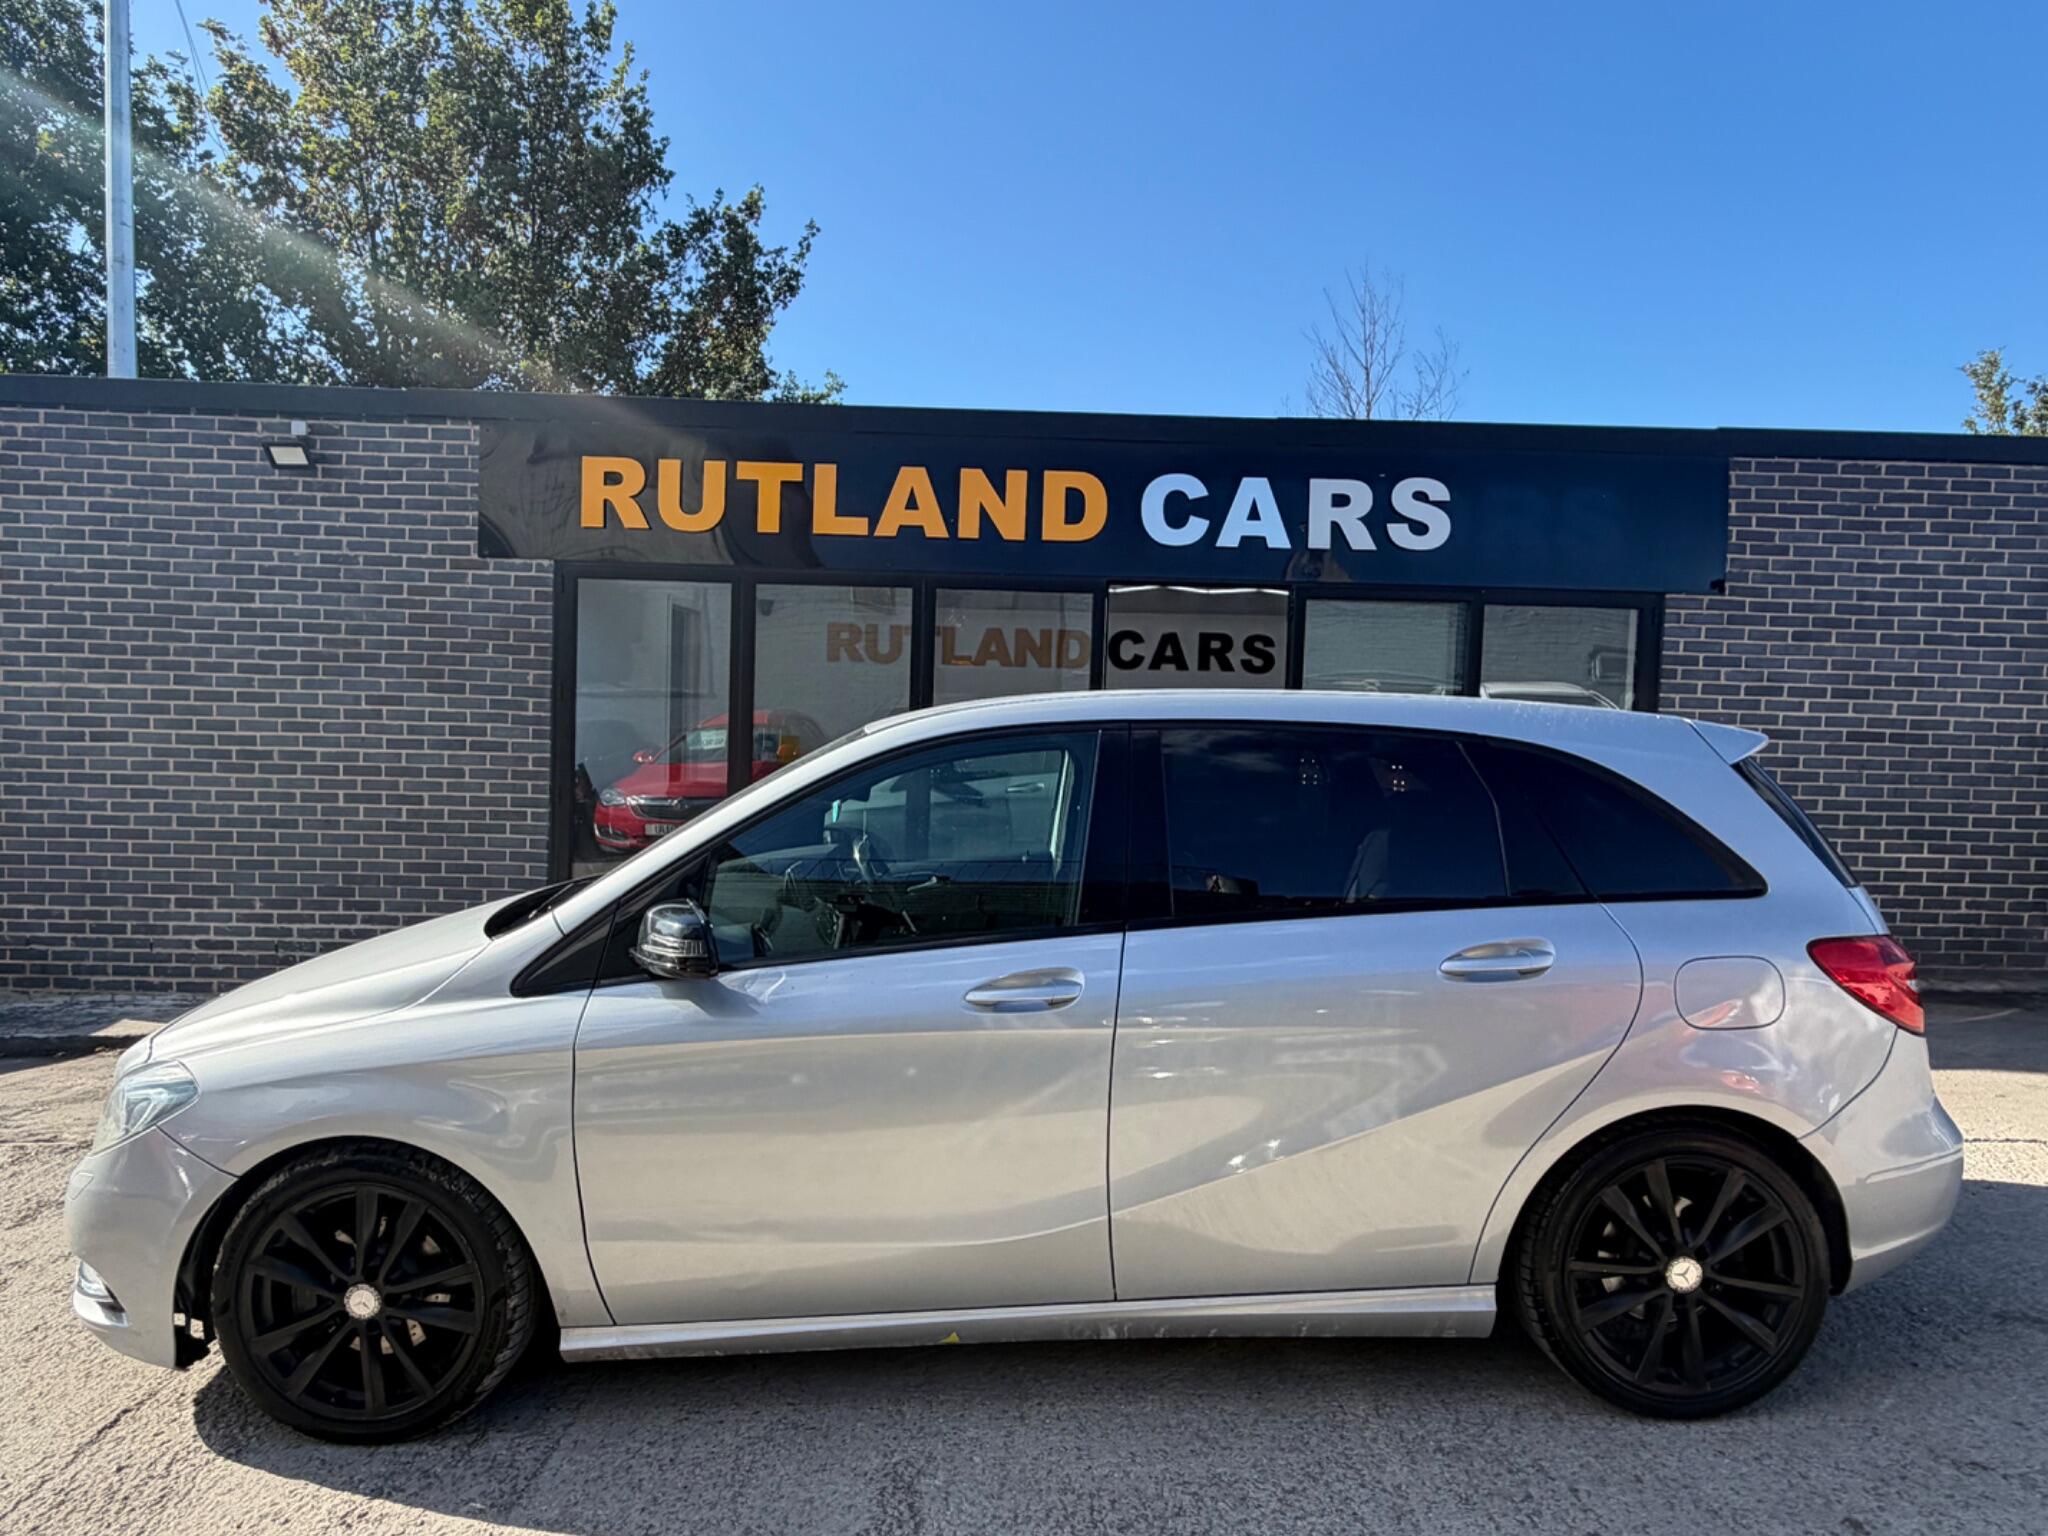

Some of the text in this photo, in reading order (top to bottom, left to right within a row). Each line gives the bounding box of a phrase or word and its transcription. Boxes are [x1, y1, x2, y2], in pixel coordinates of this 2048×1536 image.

[579, 455, 1453, 553] RUTLAND CARS
[826, 622, 1277, 675] RULAND CARS
